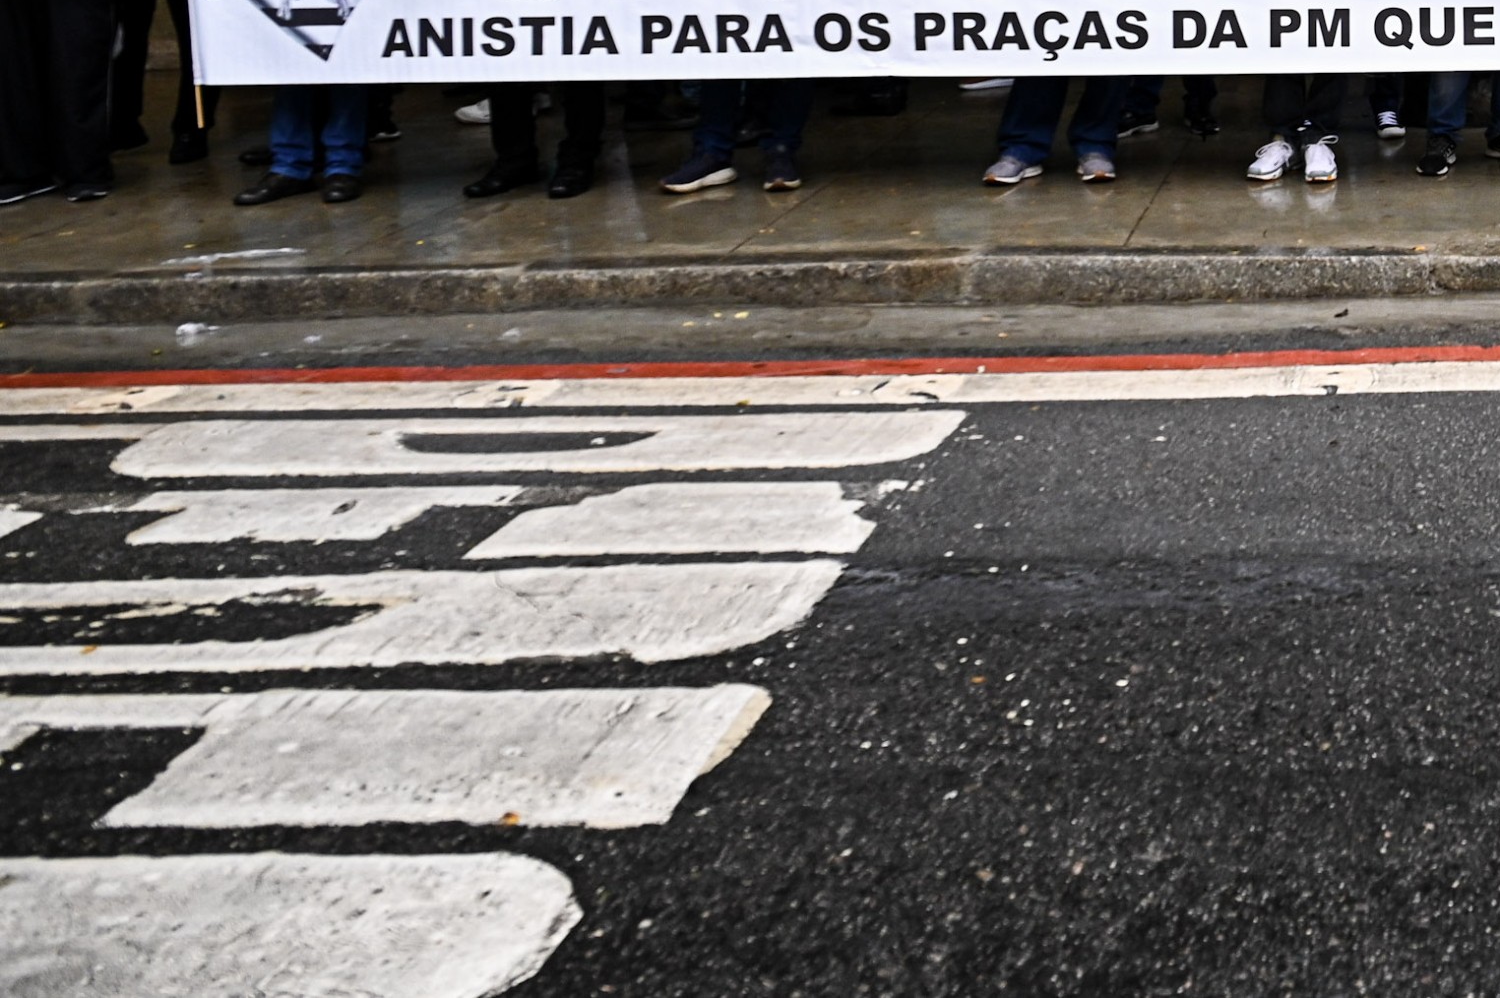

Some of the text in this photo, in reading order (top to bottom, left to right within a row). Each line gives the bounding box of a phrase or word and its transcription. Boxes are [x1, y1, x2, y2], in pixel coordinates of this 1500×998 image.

[381, 15, 619, 58] ANISTIA
[641, 14, 794, 55] PARA
[813, 12, 891, 52] OS
[914, 10, 1149, 61] PRAÇAS
[1172, 9, 1248, 49] DA
[1269, 8, 1351, 48] PM
[1373, 6, 1495, 50] QUE
